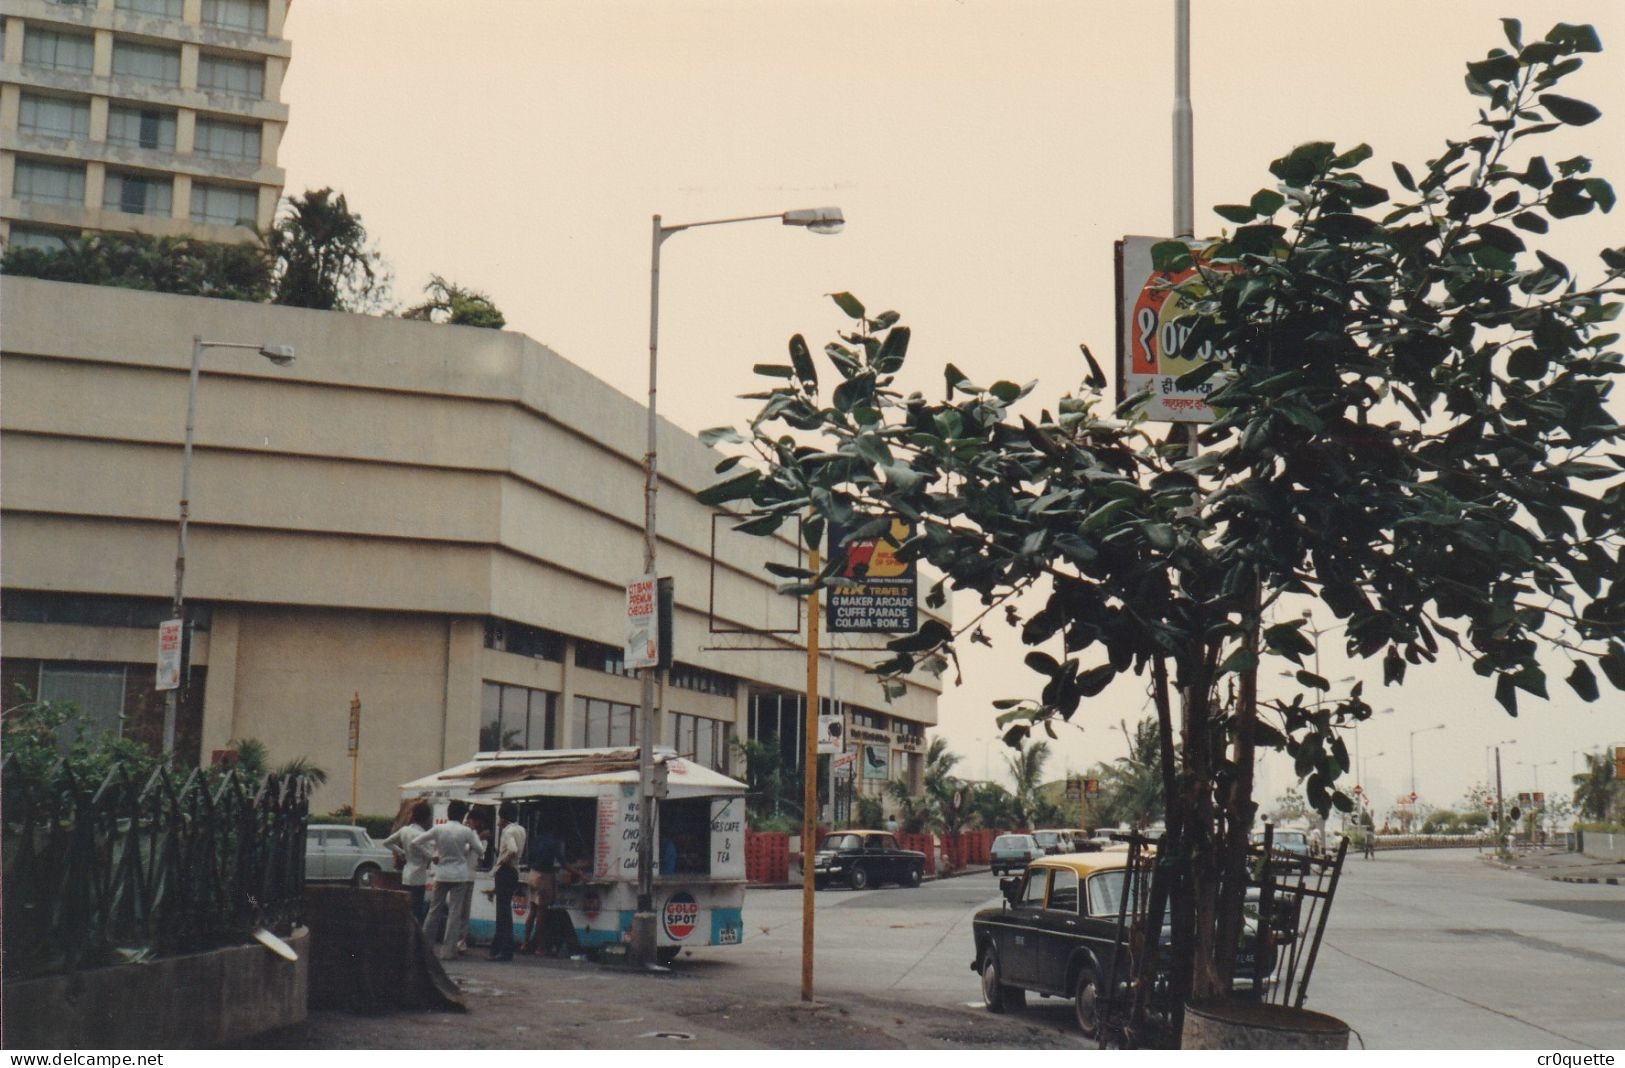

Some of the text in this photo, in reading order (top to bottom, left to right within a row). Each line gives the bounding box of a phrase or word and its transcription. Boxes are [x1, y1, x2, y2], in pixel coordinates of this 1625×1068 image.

[870, 586, 908, 596] TRAVELS
[840, 597, 873, 607] MAKER
[875, 597, 914, 608] ARCADE
[837, 607, 908, 618] CUFFE PARADE
[717, 851, 731, 863] TEA
[667, 903, 698, 914] GOLD
[667, 914, 697, 925] SPOT
